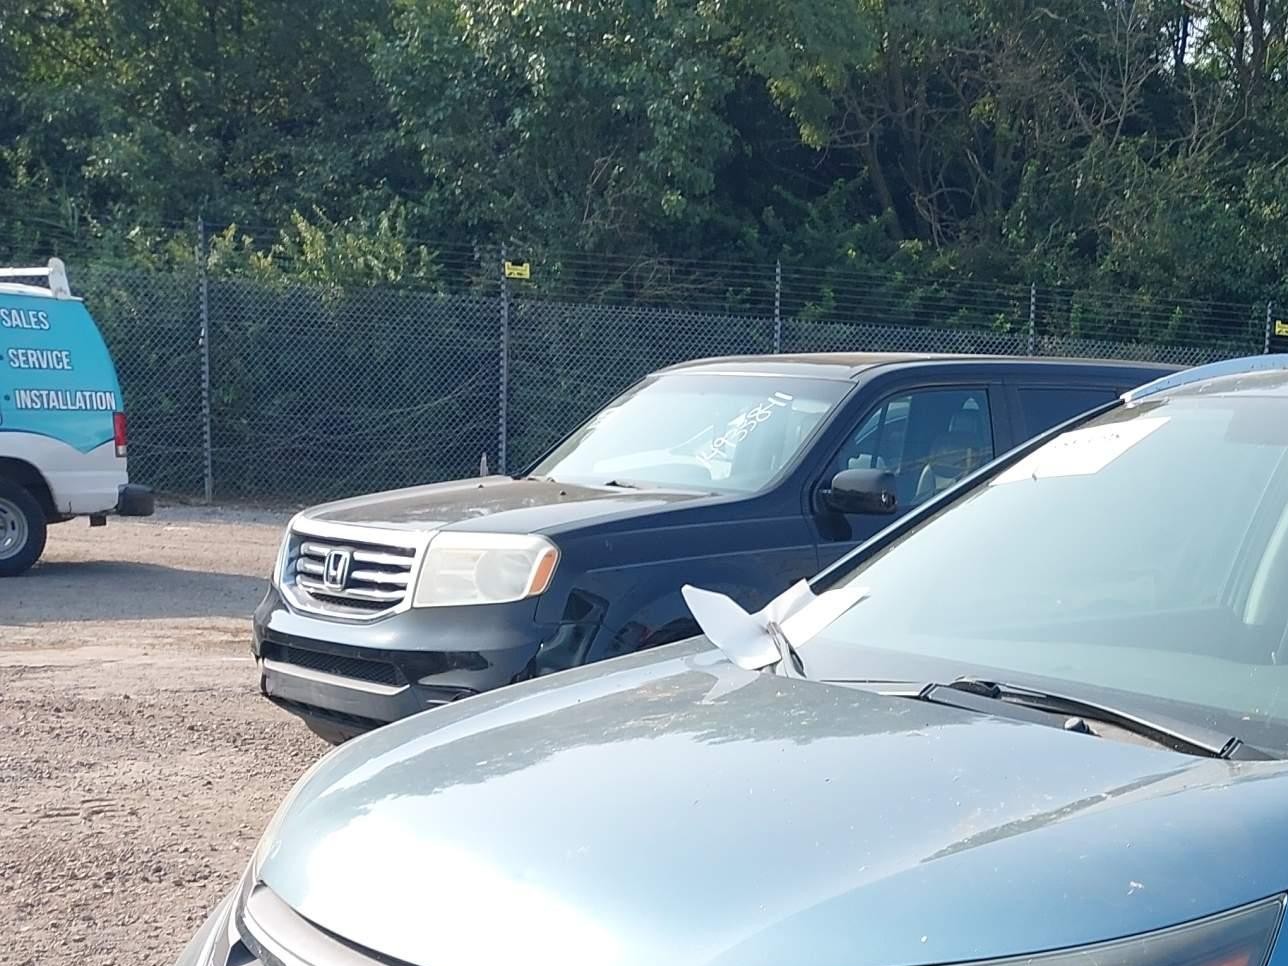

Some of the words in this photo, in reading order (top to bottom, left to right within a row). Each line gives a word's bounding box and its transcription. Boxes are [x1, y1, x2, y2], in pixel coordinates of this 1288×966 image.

[0, 308, 50, 330] SALES
[8, 348, 72, 370] SERVICE
[15, 390, 116, 411] INSTALLATION
